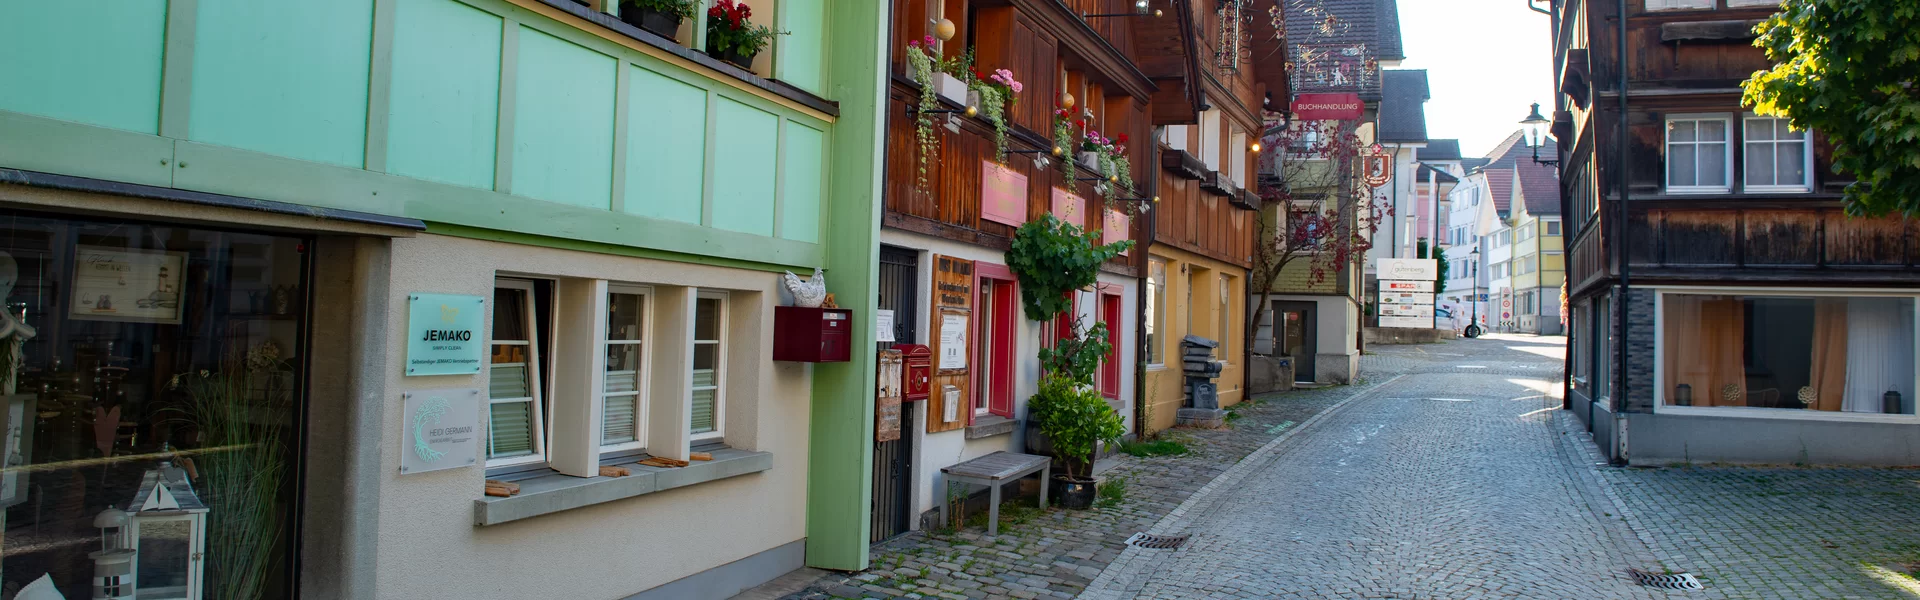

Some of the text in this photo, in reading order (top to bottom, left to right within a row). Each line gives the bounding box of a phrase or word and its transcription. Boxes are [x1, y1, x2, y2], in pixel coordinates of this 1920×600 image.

[423, 330, 472, 341] JEMAKO
[429, 426, 472, 437] HEIDI GERMANN
